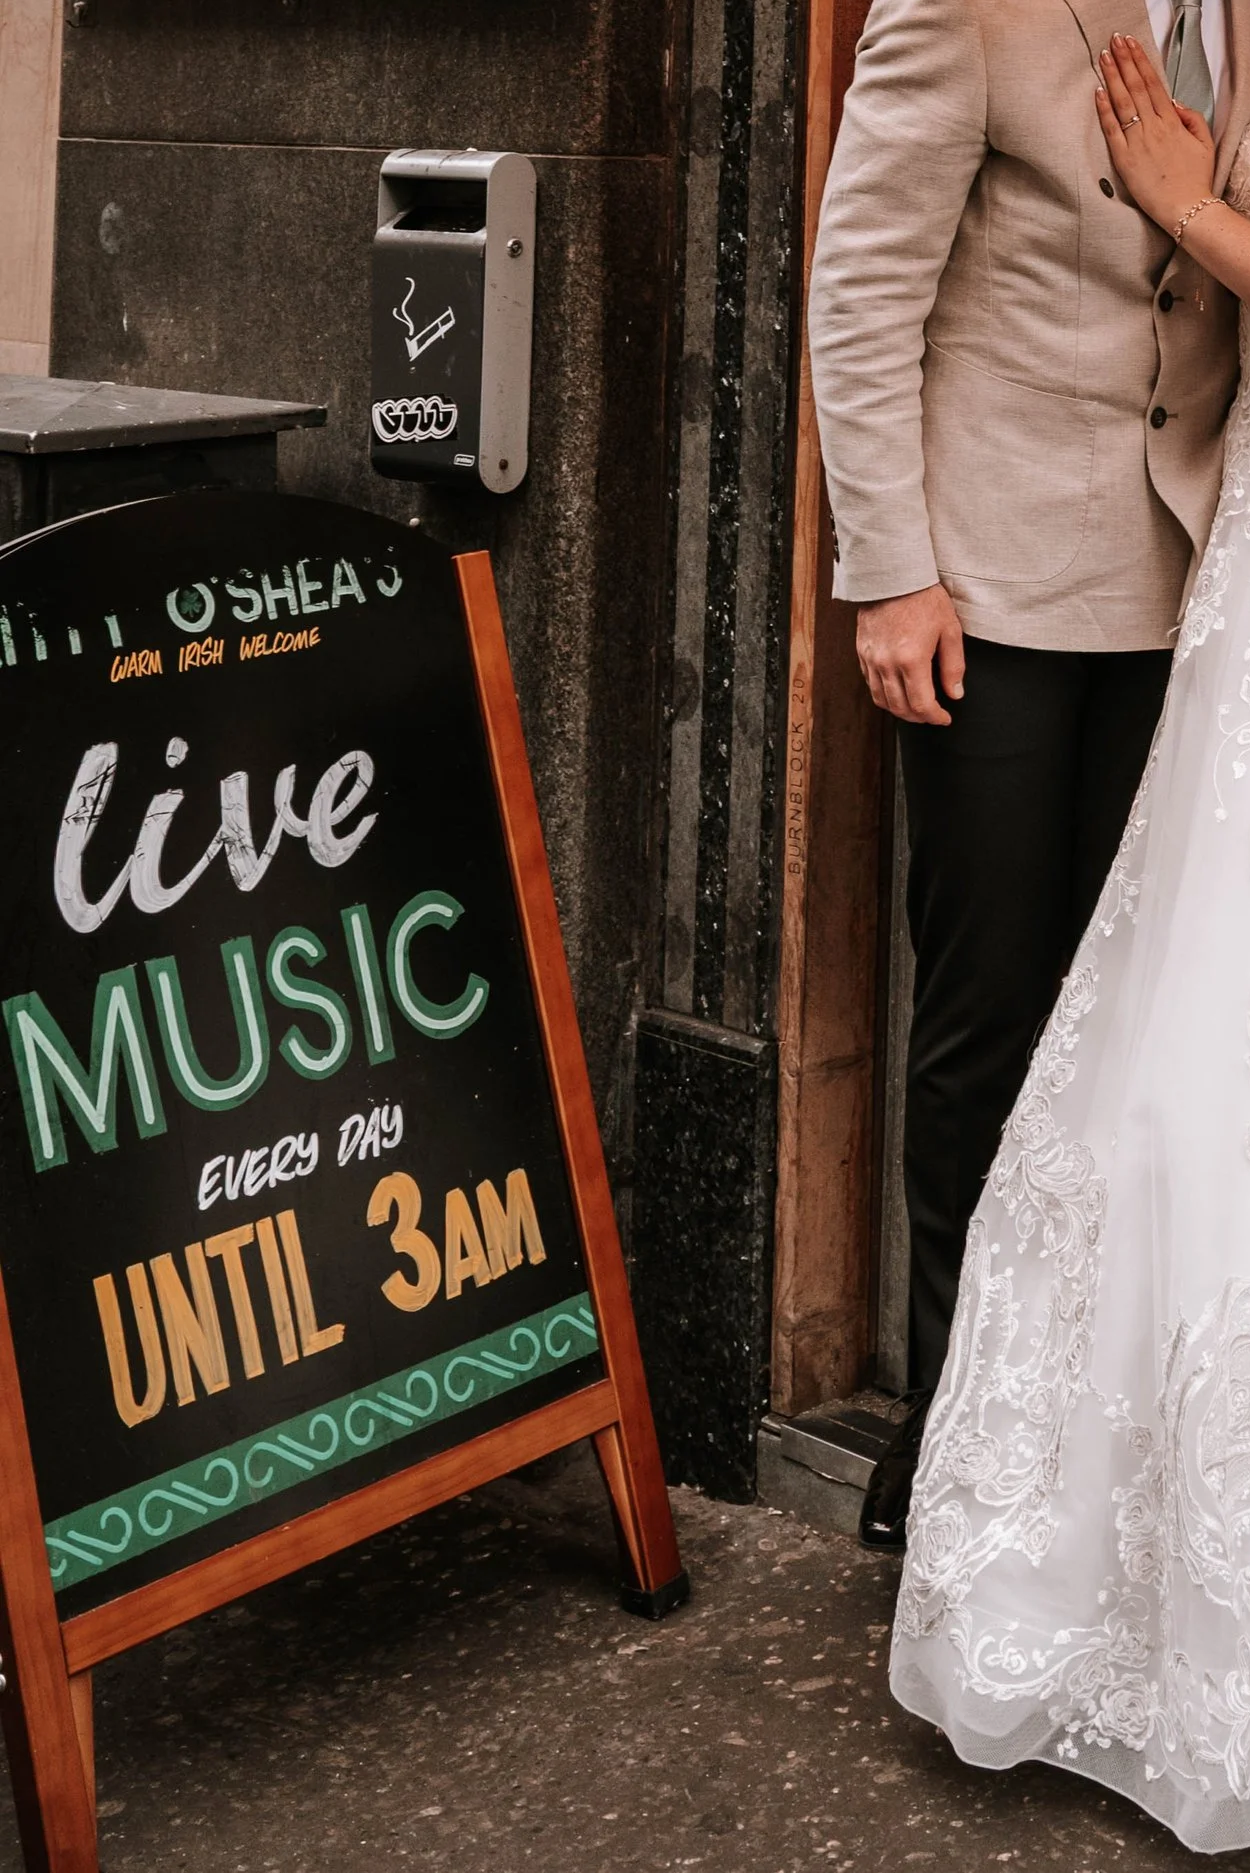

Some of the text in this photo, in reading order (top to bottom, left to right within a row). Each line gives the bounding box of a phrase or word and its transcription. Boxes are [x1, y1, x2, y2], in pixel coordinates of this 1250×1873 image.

[110, 626, 321, 683] WARM IRISH WELCOME
[53, 737, 378, 933] live
[789, 679, 805, 874] BURNBLOCK 20
[2, 890, 489, 1173] MUSIC
[197, 1103, 404, 1210] EVERY DAY
[93, 1168, 547, 1428] UNTIL 3AM
